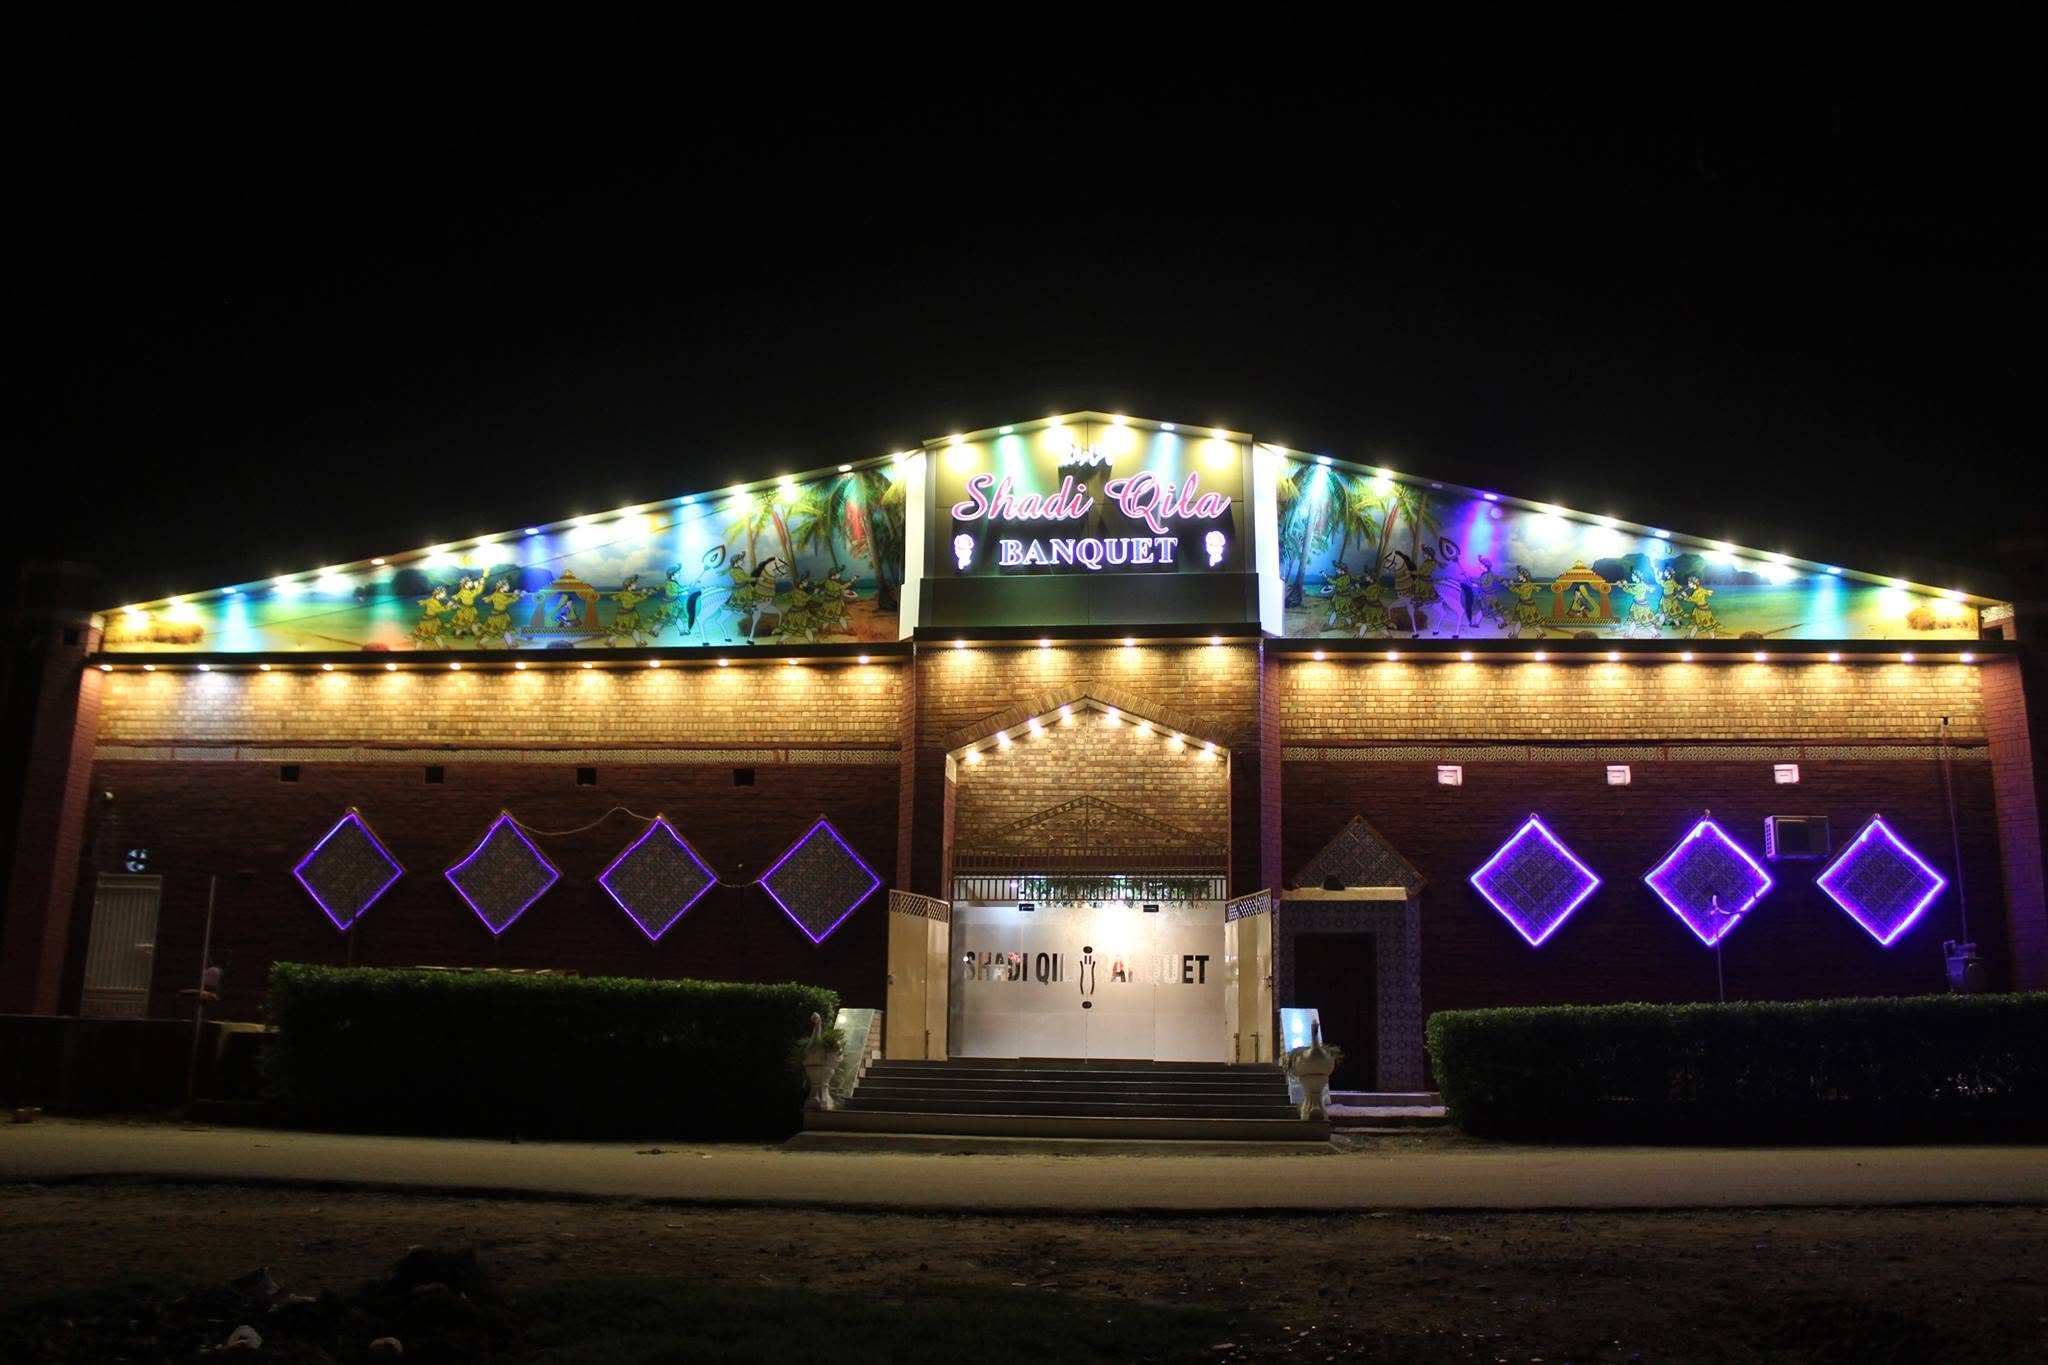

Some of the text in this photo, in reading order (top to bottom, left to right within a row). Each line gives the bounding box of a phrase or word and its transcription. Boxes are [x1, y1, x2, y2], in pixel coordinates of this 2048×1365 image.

[951, 471, 1232, 534] Shadi Qila
[999, 537, 1178, 570] BANQUET
